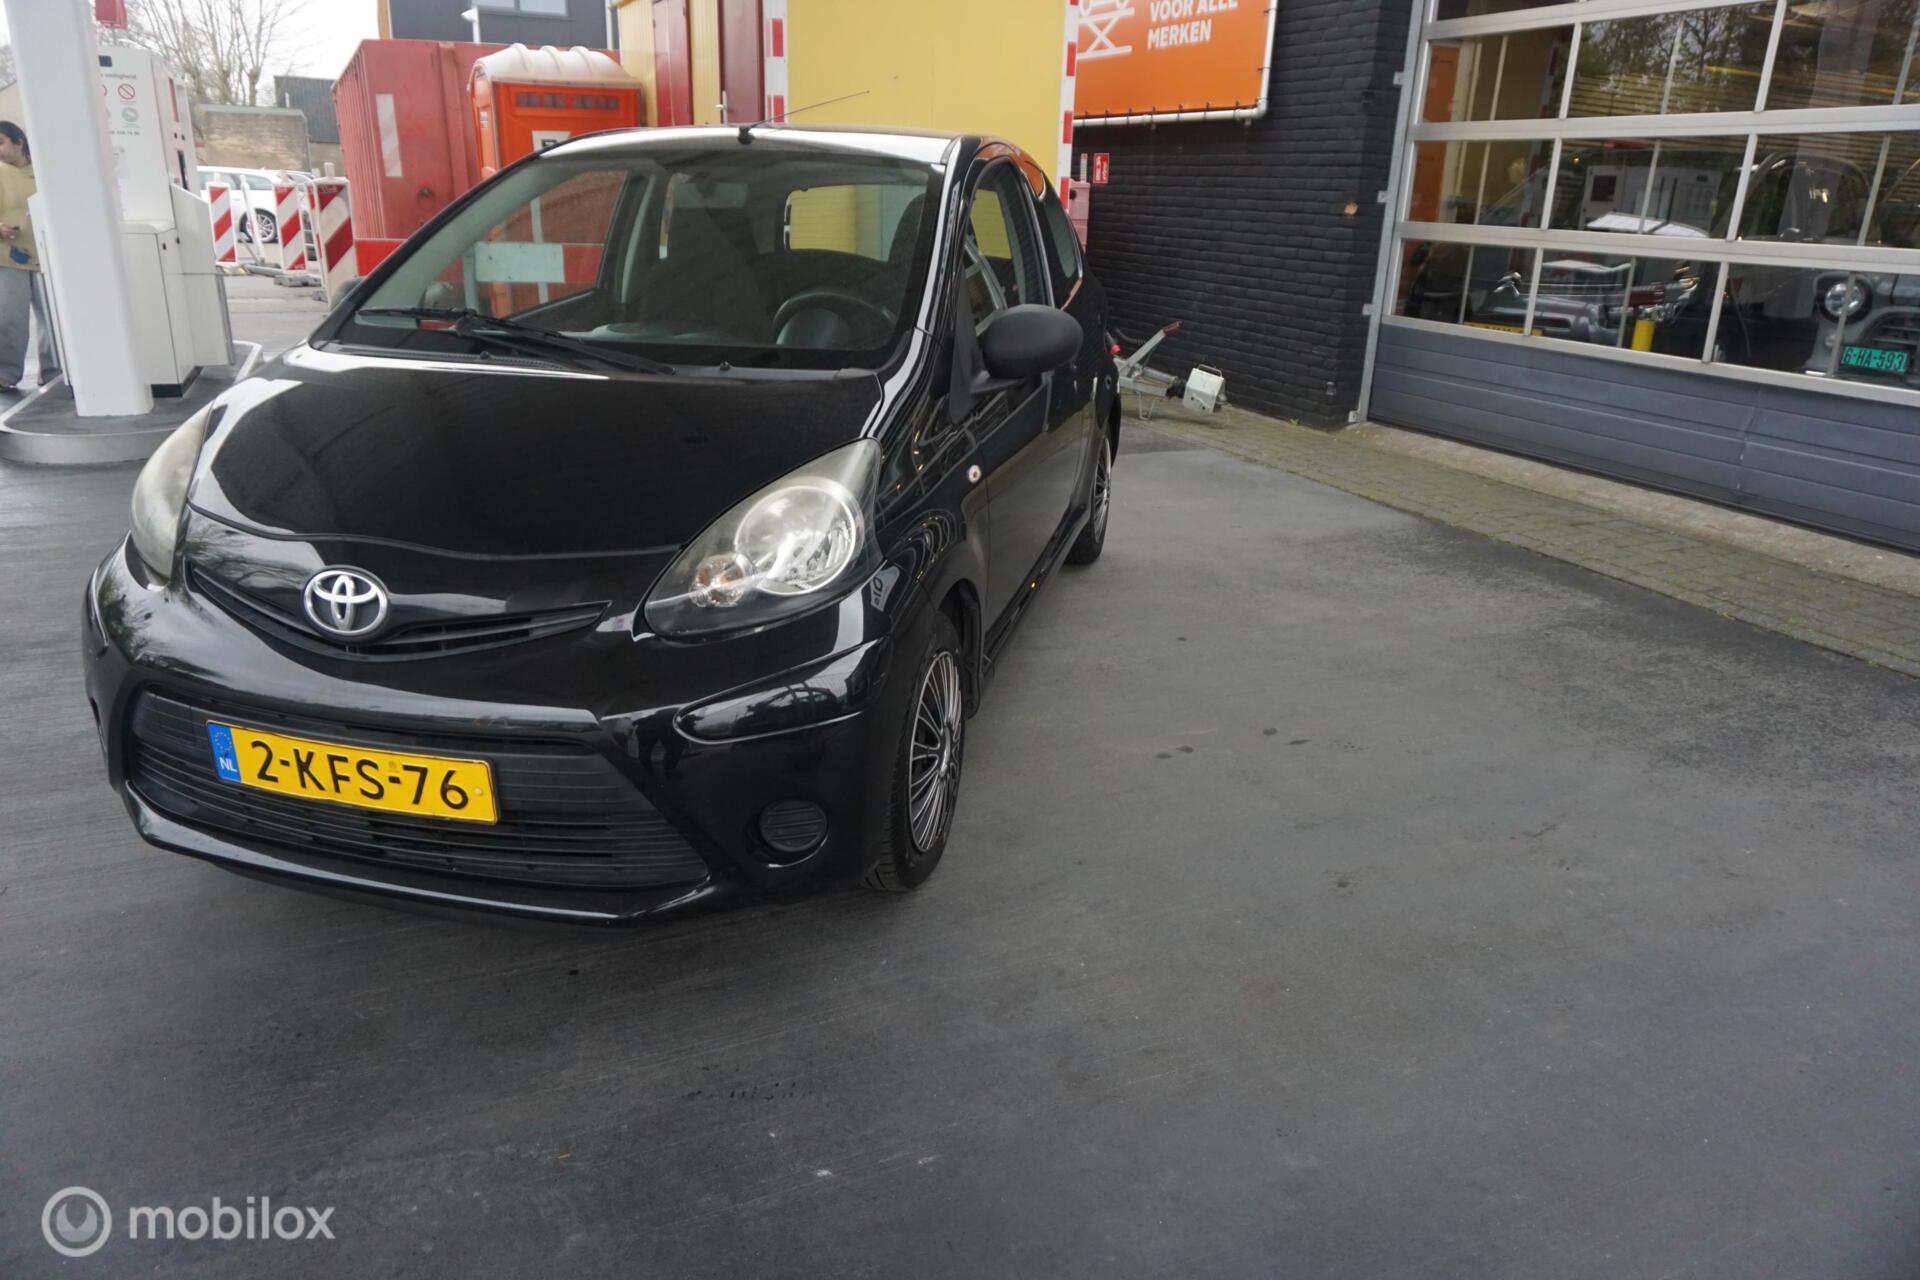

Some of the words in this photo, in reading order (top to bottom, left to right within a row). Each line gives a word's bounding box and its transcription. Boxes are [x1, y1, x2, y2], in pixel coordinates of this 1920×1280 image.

[1151, 0, 1194, 22] VOOR
[1147, 18, 1212, 50] MERKEN
[219, 757, 237, 772] NL
[251, 740, 469, 810] 2-KFS-76
